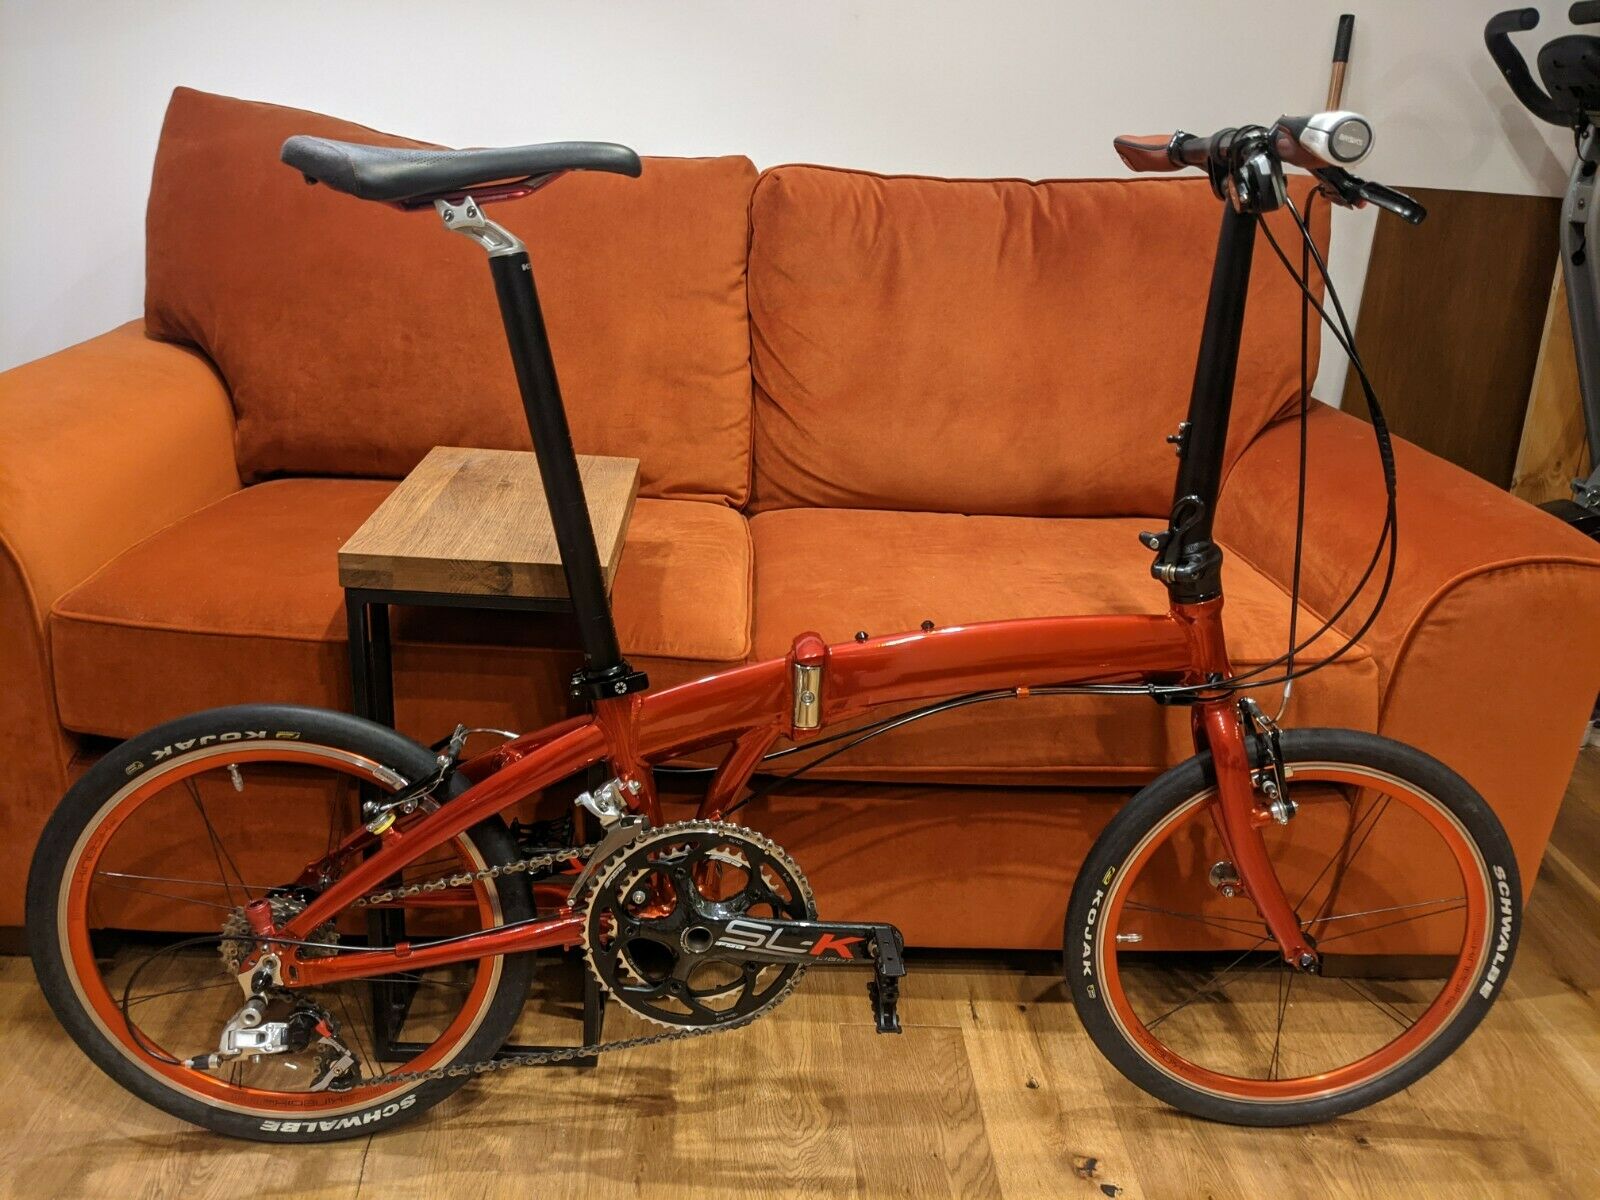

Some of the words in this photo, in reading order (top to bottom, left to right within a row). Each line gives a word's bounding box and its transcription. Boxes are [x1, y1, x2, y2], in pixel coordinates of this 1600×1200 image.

[151, 730, 267, 761] KOJAK
[1082, 889, 1104, 977] KOJAK
[1479, 864, 1514, 1000] SCHWALBE
[259, 1093, 417, 1133] SCHWALBE
